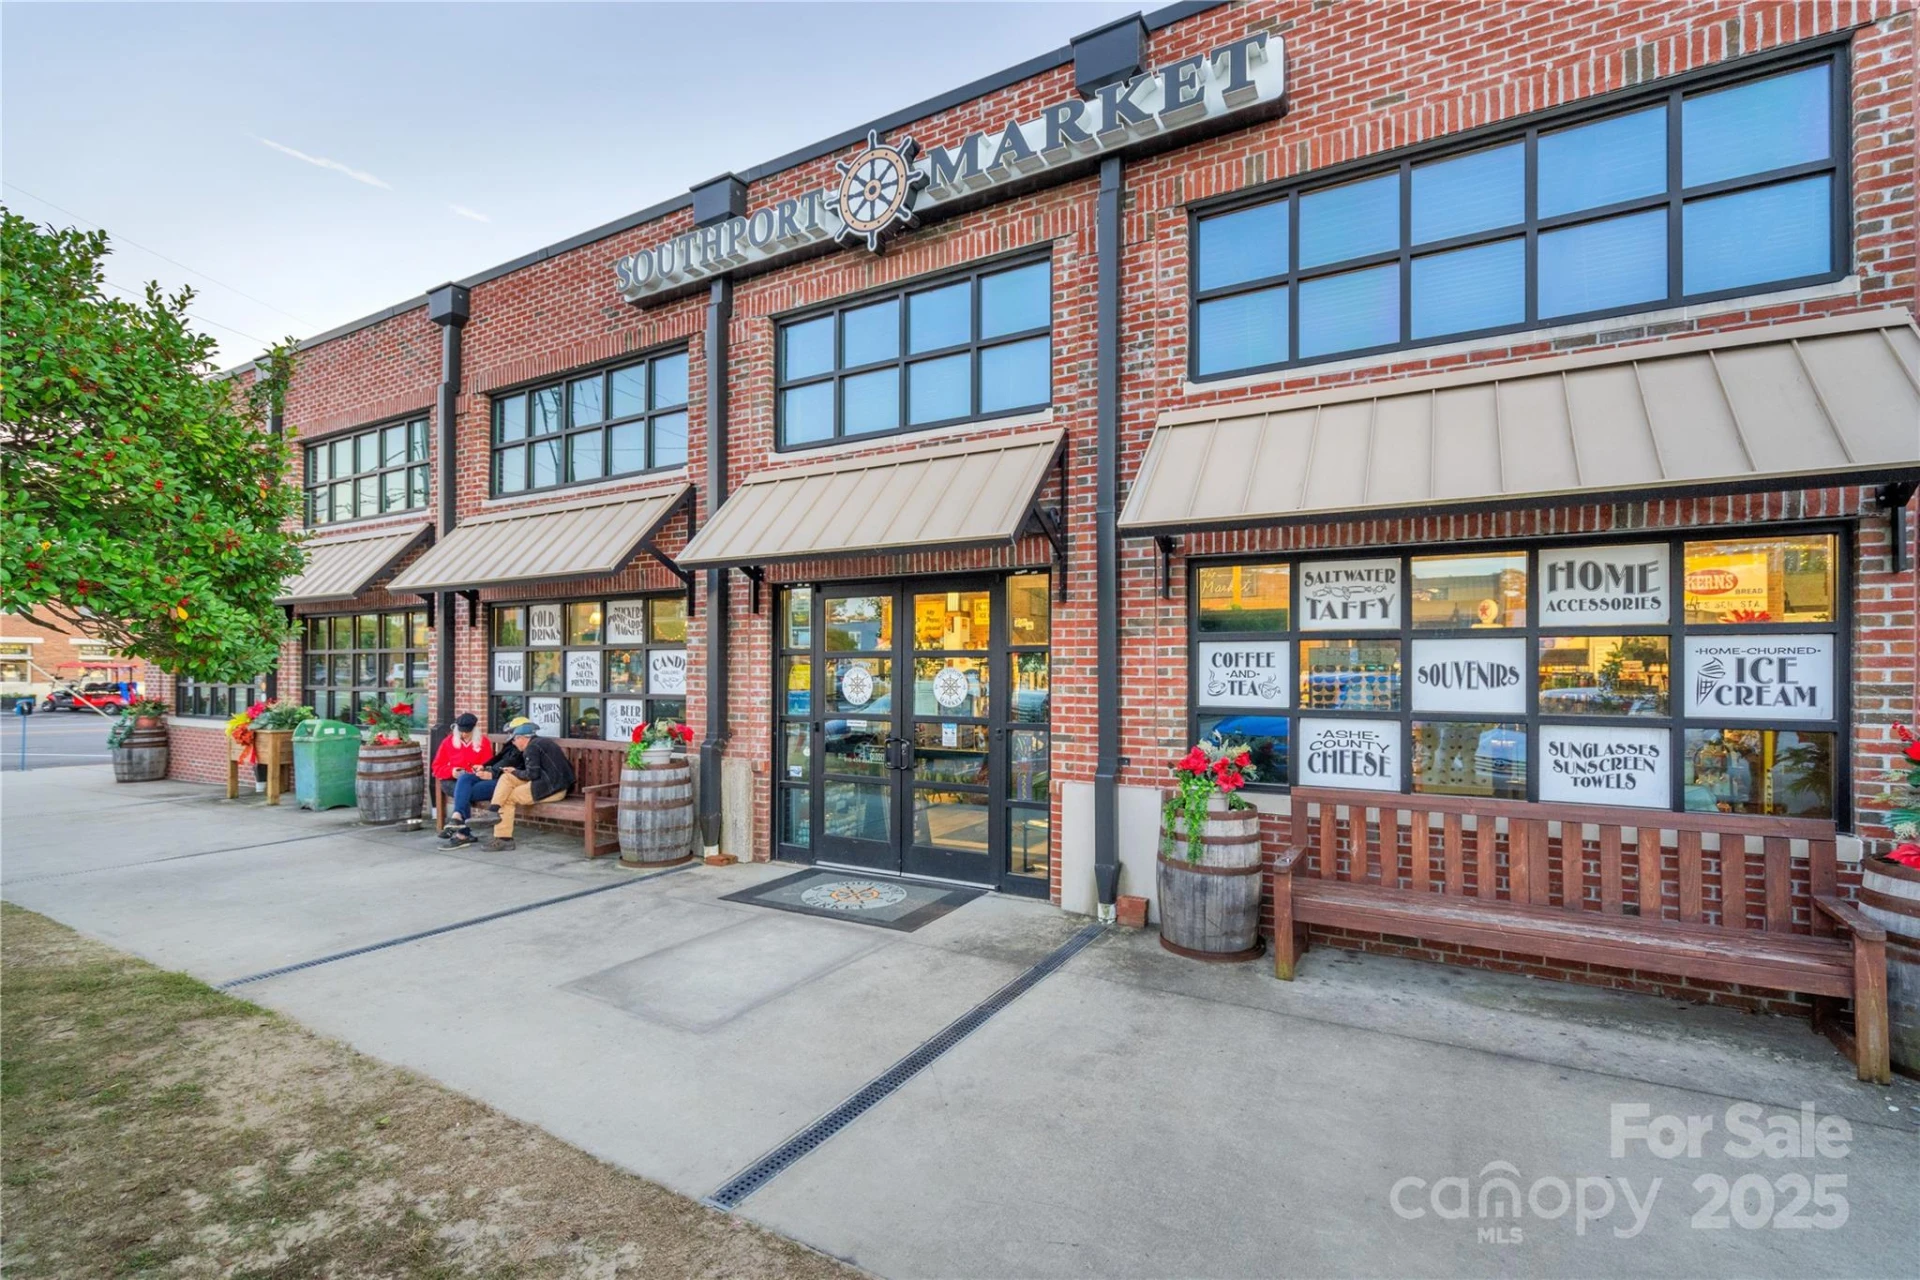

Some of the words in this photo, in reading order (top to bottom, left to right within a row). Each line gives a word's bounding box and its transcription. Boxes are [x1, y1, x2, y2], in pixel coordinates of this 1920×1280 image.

[926, 30, 1270, 191] MARKET
[616, 187, 829, 294] SOUTHPORT
[1304, 568, 1397, 587] SALTWATER
[1547, 560, 1661, 595] HOME
[1305, 593, 1396, 620] TAFFY
[1545, 596, 1662, 612] ACCESSORIES
[531, 610, 555, 628] COLD
[531, 628, 561, 641] DRINKS
[1211, 652, 1276, 668] COFFEE
[1699, 647, 1817, 655] HOME-CHURNED
[652, 656, 686, 672] CANDY
[1735, 656, 1799, 685] ICE
[498, 665, 522, 684] FUDGE
[1417, 660, 1520, 690] SOUVENIRS
[1227, 680, 1258, 696] TEA
[1715, 684, 1817, 707] CREAM
[533, 703, 561, 714] T-SHIRTS
[543, 712, 561, 723] HATS
[620, 705, 641, 717] BEER
[1309, 739, 1391, 753] COUNTY
[1548, 741, 1660, 759] SUNGLASSES
[1307, 749, 1392, 777] CHEESE
[1552, 756, 1656, 774] SUNSCREEN
[1570, 772, 1637, 790] TOWELS
